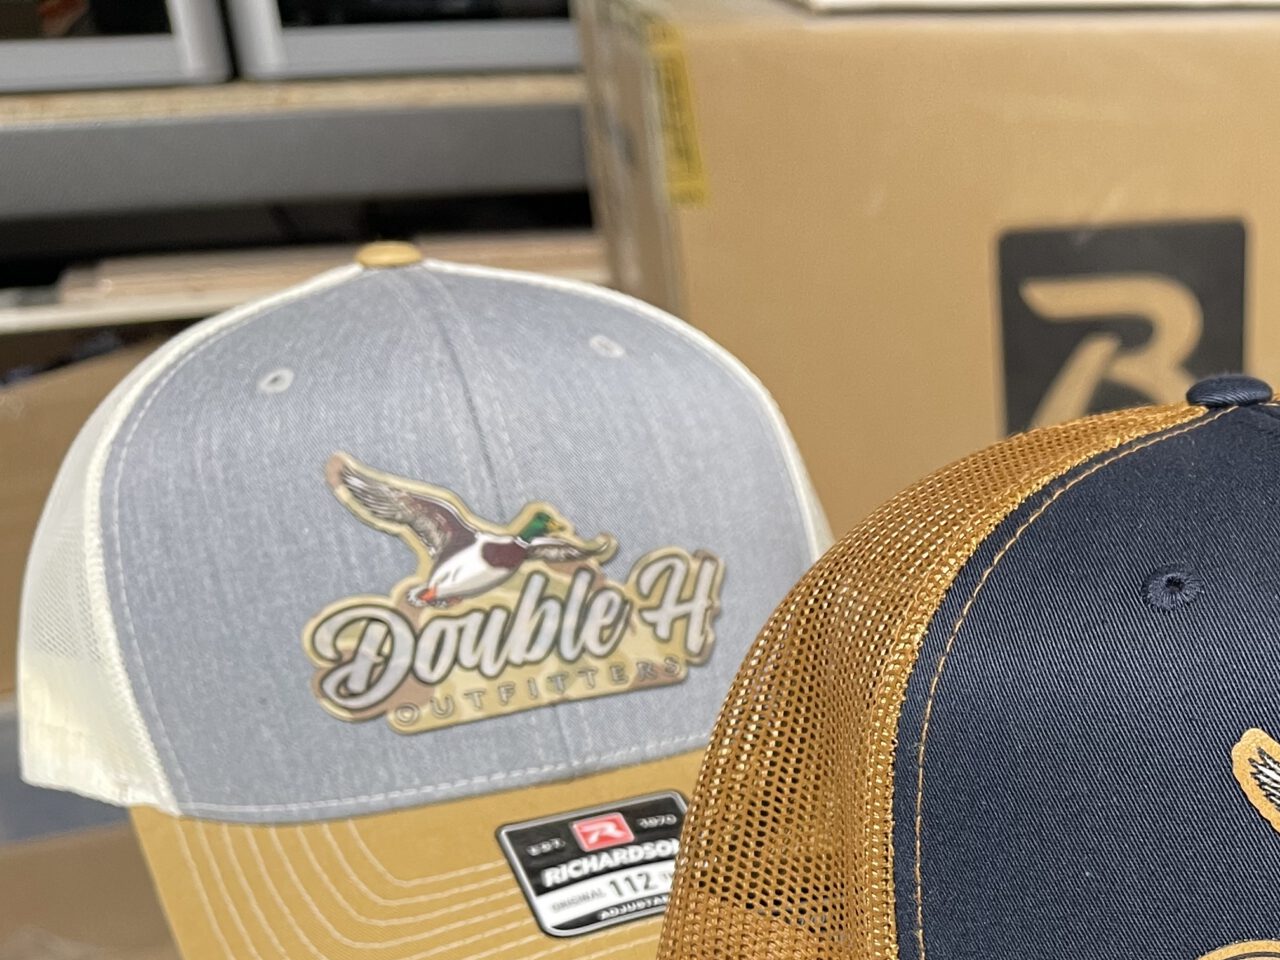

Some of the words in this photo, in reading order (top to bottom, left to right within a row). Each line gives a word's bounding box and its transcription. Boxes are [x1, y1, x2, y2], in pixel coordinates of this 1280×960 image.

[313, 568, 631, 708] Double
[635, 553, 714, 655] H
[393, 655, 686, 726] OUTFITTERS
[599, 894, 668, 920] ADJUSTA
[609, 872, 658, 898] 112
